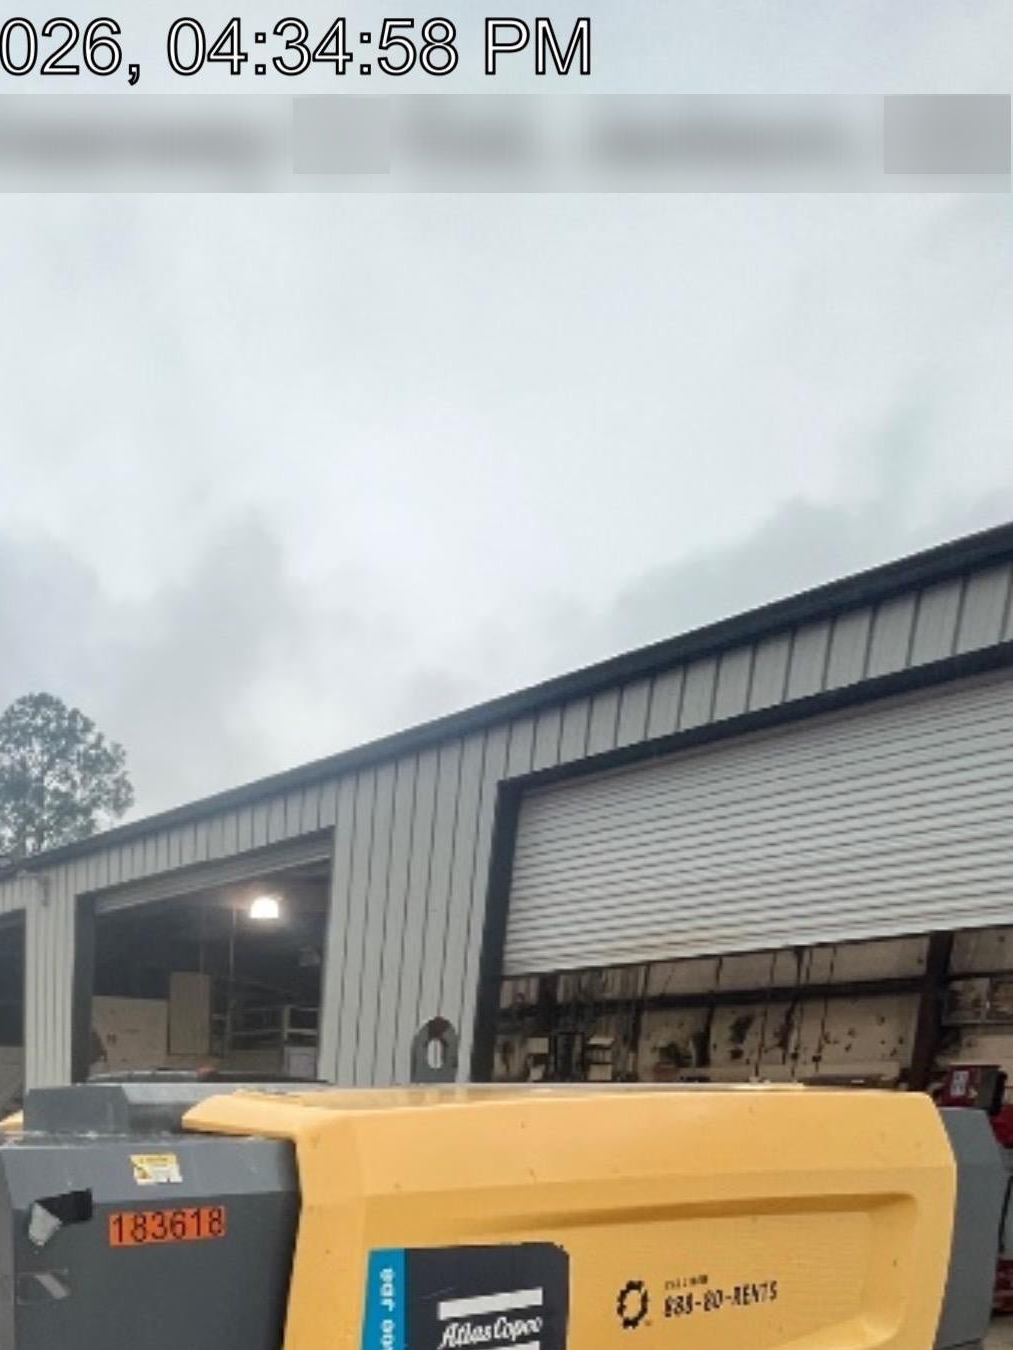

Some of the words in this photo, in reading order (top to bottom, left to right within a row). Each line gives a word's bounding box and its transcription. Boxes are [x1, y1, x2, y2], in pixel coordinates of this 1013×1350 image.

[112, 1207, 223, 1243] 183618
[437, 1321, 492, 1350] Atlas
[493, 1316, 543, 1342] Copco
